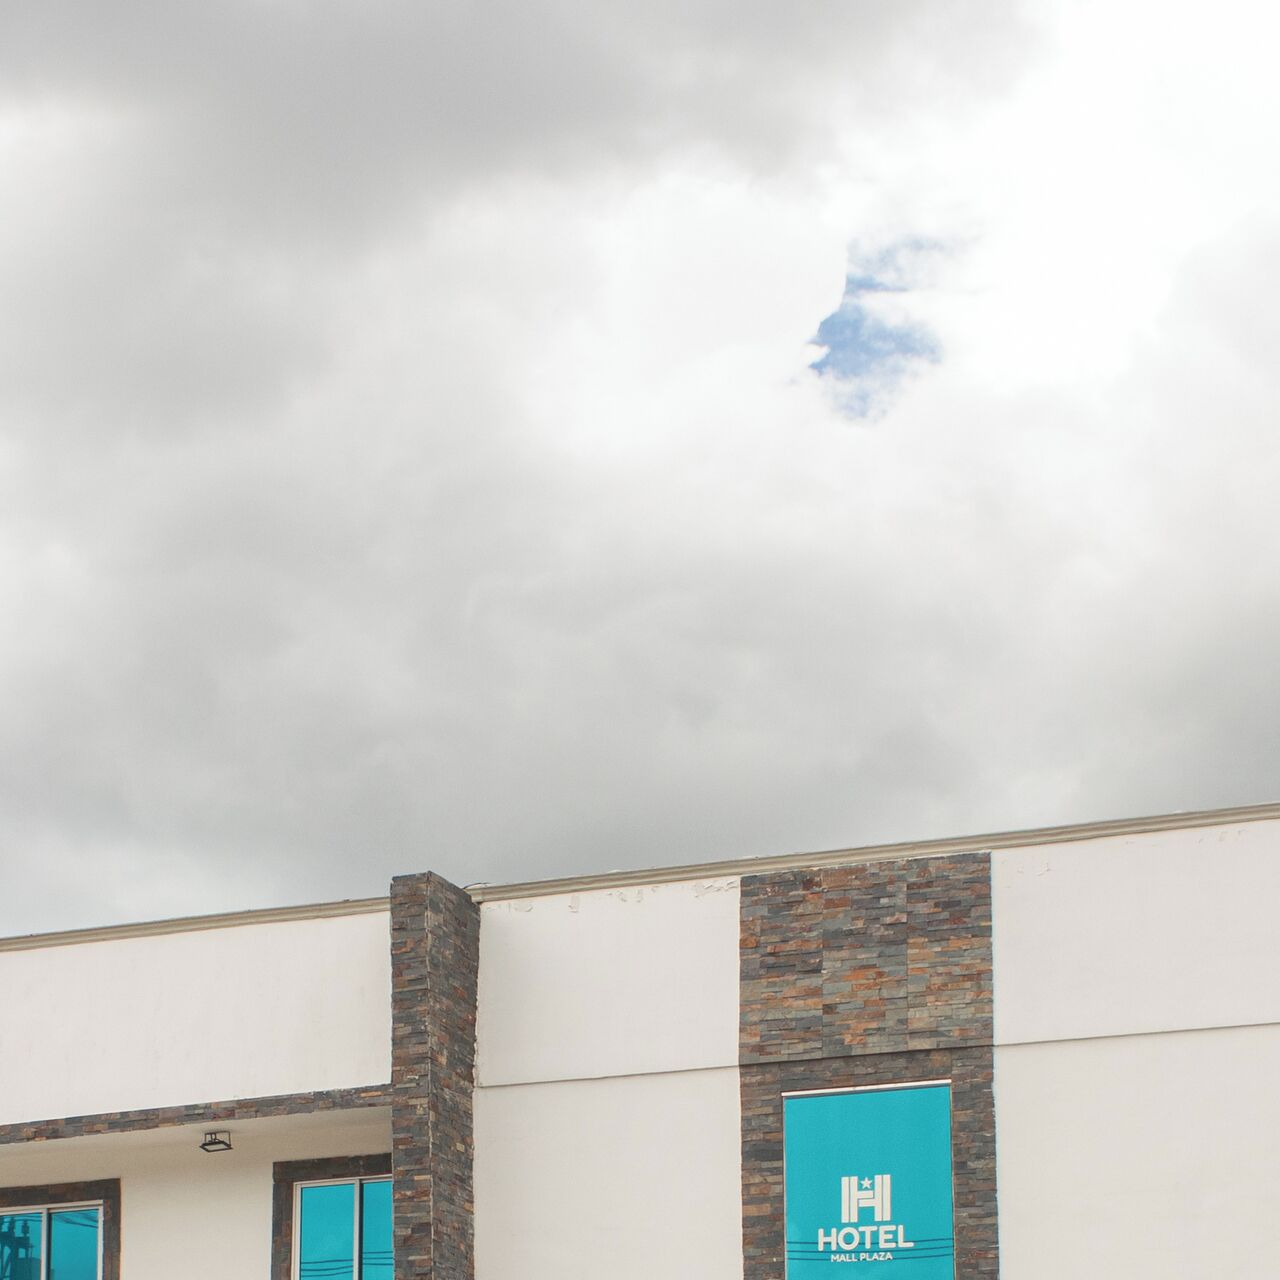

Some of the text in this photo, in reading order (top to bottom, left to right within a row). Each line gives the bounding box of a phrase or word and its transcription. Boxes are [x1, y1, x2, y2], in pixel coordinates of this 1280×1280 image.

[818, 1225, 915, 1251] HOTEL
[831, 1252, 893, 1262] MALL PLAZA
